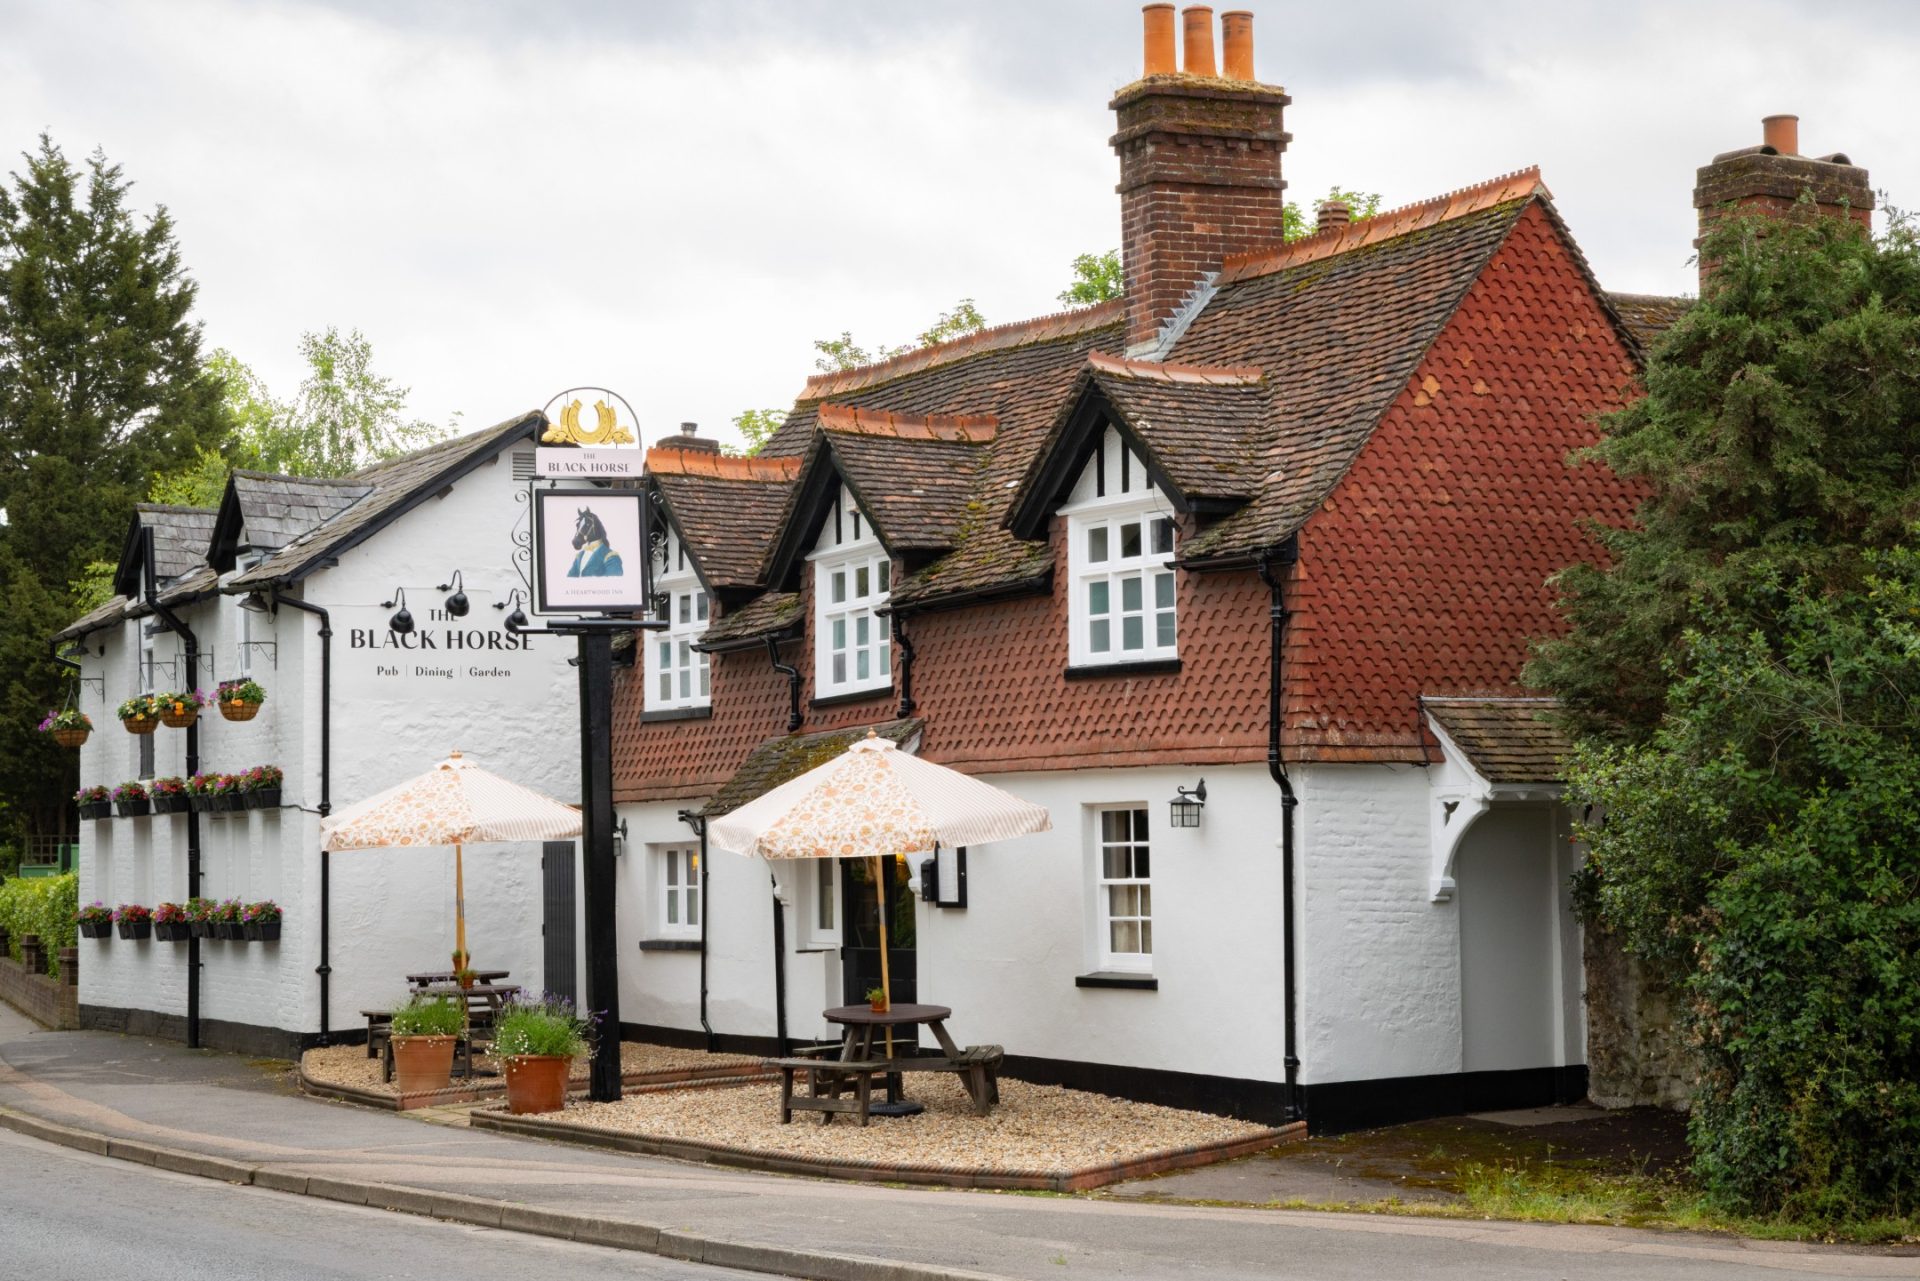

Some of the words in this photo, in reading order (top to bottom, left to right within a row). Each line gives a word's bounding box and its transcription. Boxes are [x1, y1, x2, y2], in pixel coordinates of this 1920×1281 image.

[548, 462, 588, 473] BLACK
[590, 462, 631, 473] HORSE
[351, 629, 437, 649] BLACK
[446, 630, 535, 651] HORSE
[377, 665, 399, 676] Pub
[415, 666, 454, 679] Dining
[469, 666, 512, 677] Garden
